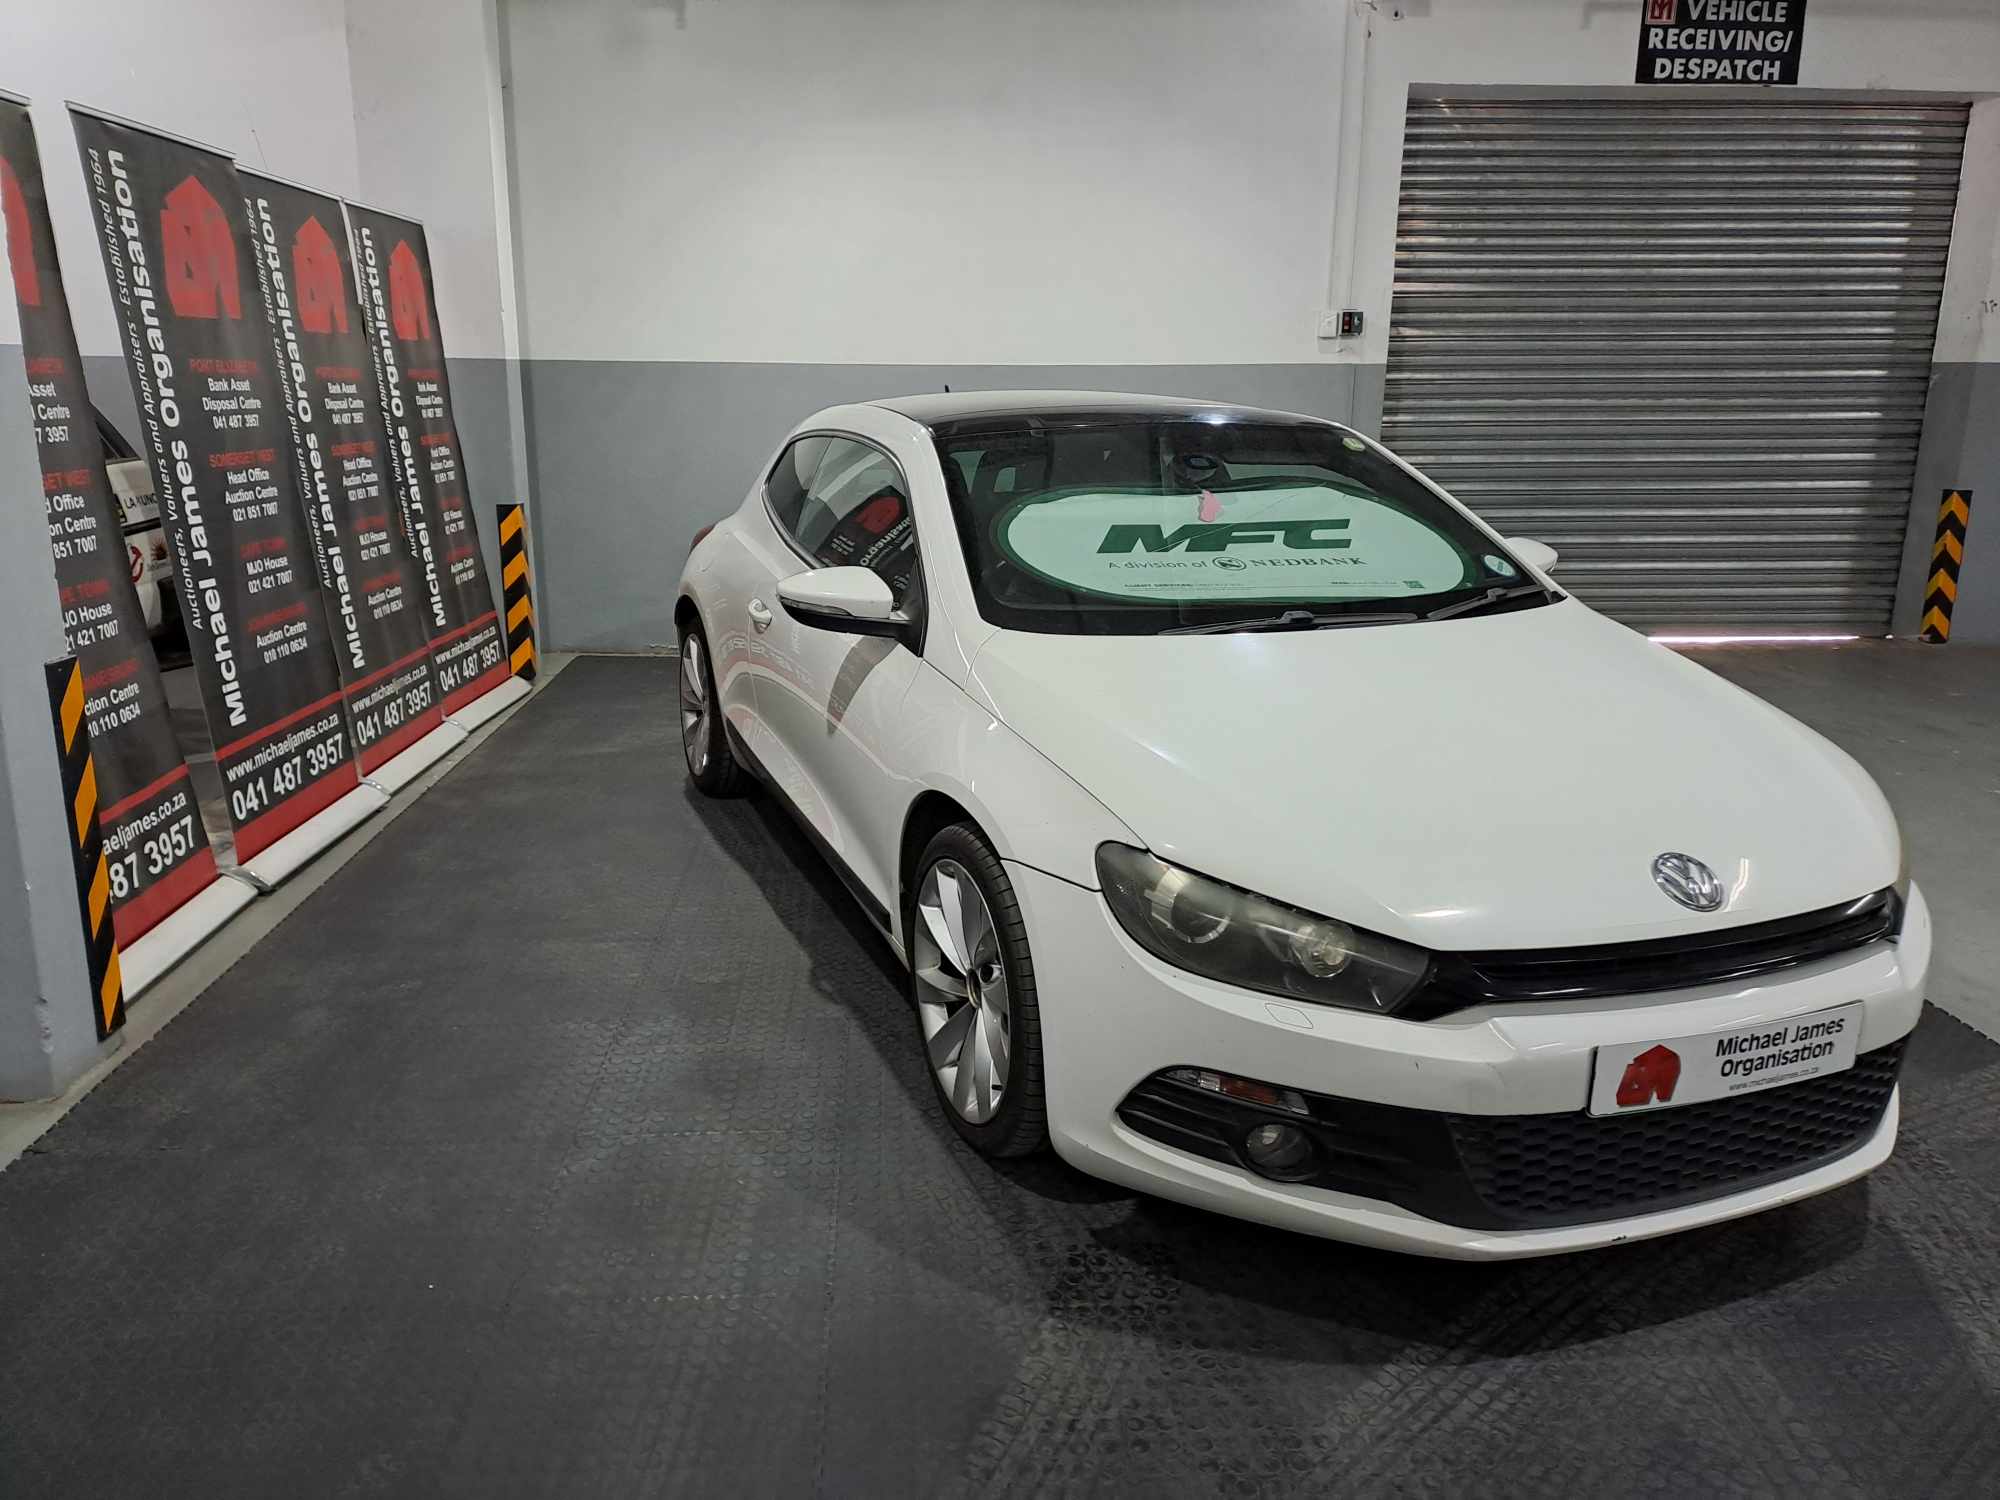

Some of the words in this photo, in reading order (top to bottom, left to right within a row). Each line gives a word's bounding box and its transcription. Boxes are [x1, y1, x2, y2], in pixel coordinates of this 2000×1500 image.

[1688, 0, 1788, 22] VEHICLE
[1648, 27, 1794, 53] RECEIVING/
[1654, 57, 1781, 81] DESPATCH
[88, 147, 107, 194] 1964
[98, 198, 131, 305] Established
[107, 149, 180, 428] Organisation
[257, 198, 312, 423] Organisation
[361, 227, 404, 418] Organisation
[127, 321, 156, 416] Appraisers
[208, 378, 229, 391] Bank
[231, 378, 251, 391] Asset
[273, 337, 295, 413] Appraisers
[37, 403, 70, 420] Centre
[202, 397, 239, 413] Disposal
[213, 416, 228, 430] 041
[45, 425, 69, 443] 3957
[147, 419, 163, 453] and
[288, 415, 301, 443] and
[227, 470, 248, 485] Head
[247, 468, 270, 482] Office
[296, 447, 312, 499] Valuers
[306, 432, 338, 537] James
[397, 426, 424, 514] James
[53, 494, 85, 512] Office
[158, 458, 178, 521] Valuers
[171, 440, 212, 567] James
[225, 488, 255, 504] Auction
[64, 515, 97, 533] Centre
[232, 508, 247, 521] 021
[53, 540, 73, 559] 851
[74, 535, 97, 554] 7007
[1096, 518, 1351, 554] MFC
[174, 528, 203, 629] Auctioneers,
[263, 556, 289, 571] House
[415, 522, 447, 627] Michael
[1123, 559, 1188, 570] division
[1192, 559, 1208, 569] of
[1249, 556, 1369, 568] NEDBANK
[79, 603, 113, 624] House
[327, 546, 365, 669] Michael
[77, 627, 96, 647] 421
[97, 619, 120, 641] 7007
[256, 629, 283, 649] Auction
[283, 620, 308, 639] Centre
[198, 578, 247, 727] Michael
[440, 663, 461, 691] 041
[462, 652, 479, 678] 487
[480, 640, 500, 668] 3957
[110, 681, 140, 705] Centre
[99, 711, 118, 732] 110
[119, 701, 141, 724] 0634
[356, 711, 382, 745] 041
[384, 697, 404, 728] 487
[405, 680, 432, 715] 3957
[226, 712, 339, 783] www.michaeljames.co.za
[232, 775, 269, 821] 041
[273, 755, 303, 797] 487
[306, 732, 344, 776] 3957
[102, 791, 188, 856] aeljames.co.za
[143, 814, 194, 875] 3957
[1716, 1027, 1788, 1057] Michael
[1790, 1017, 1845, 1042] James
[1720, 1041, 1834, 1077] Organisation
